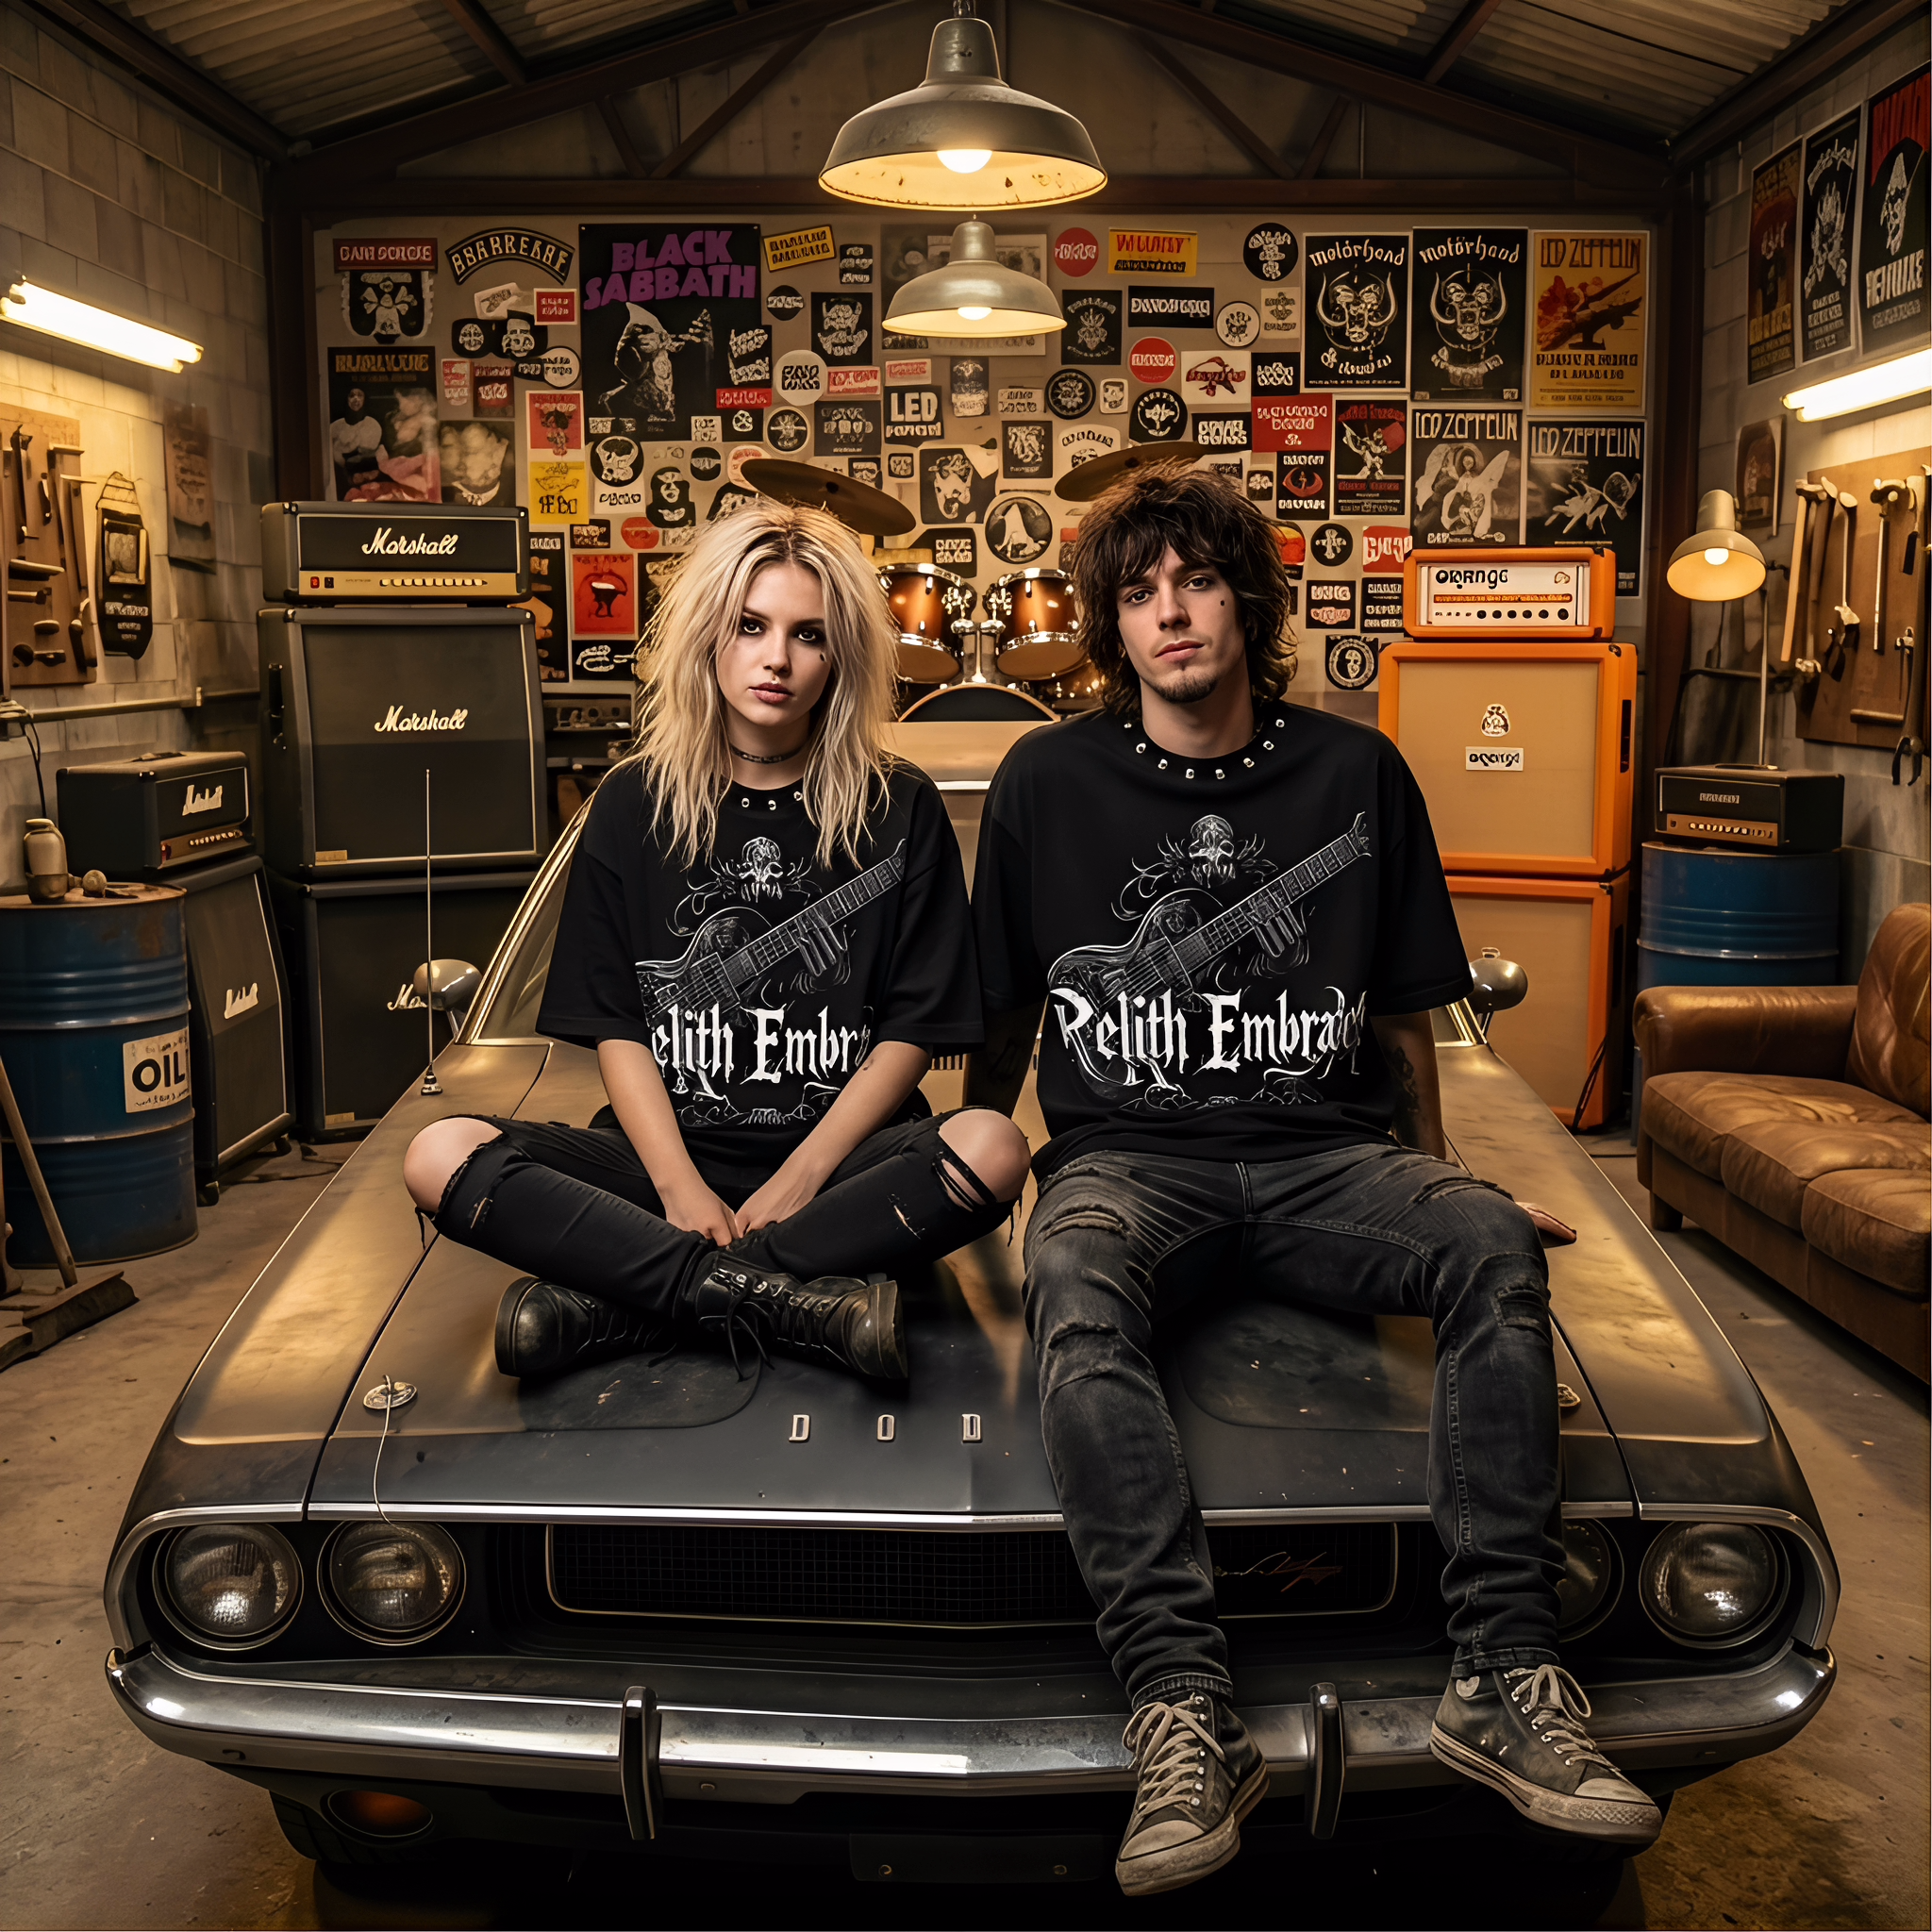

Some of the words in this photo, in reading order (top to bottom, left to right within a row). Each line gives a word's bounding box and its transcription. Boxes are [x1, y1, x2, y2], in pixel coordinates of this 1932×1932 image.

[611, 231, 733, 272] BLACK
[583, 265, 757, 310] SABBATH
[891, 391, 939, 422] LED
[651, 1003, 735, 1084] elith
[132, 1051, 186, 1092] OIL
